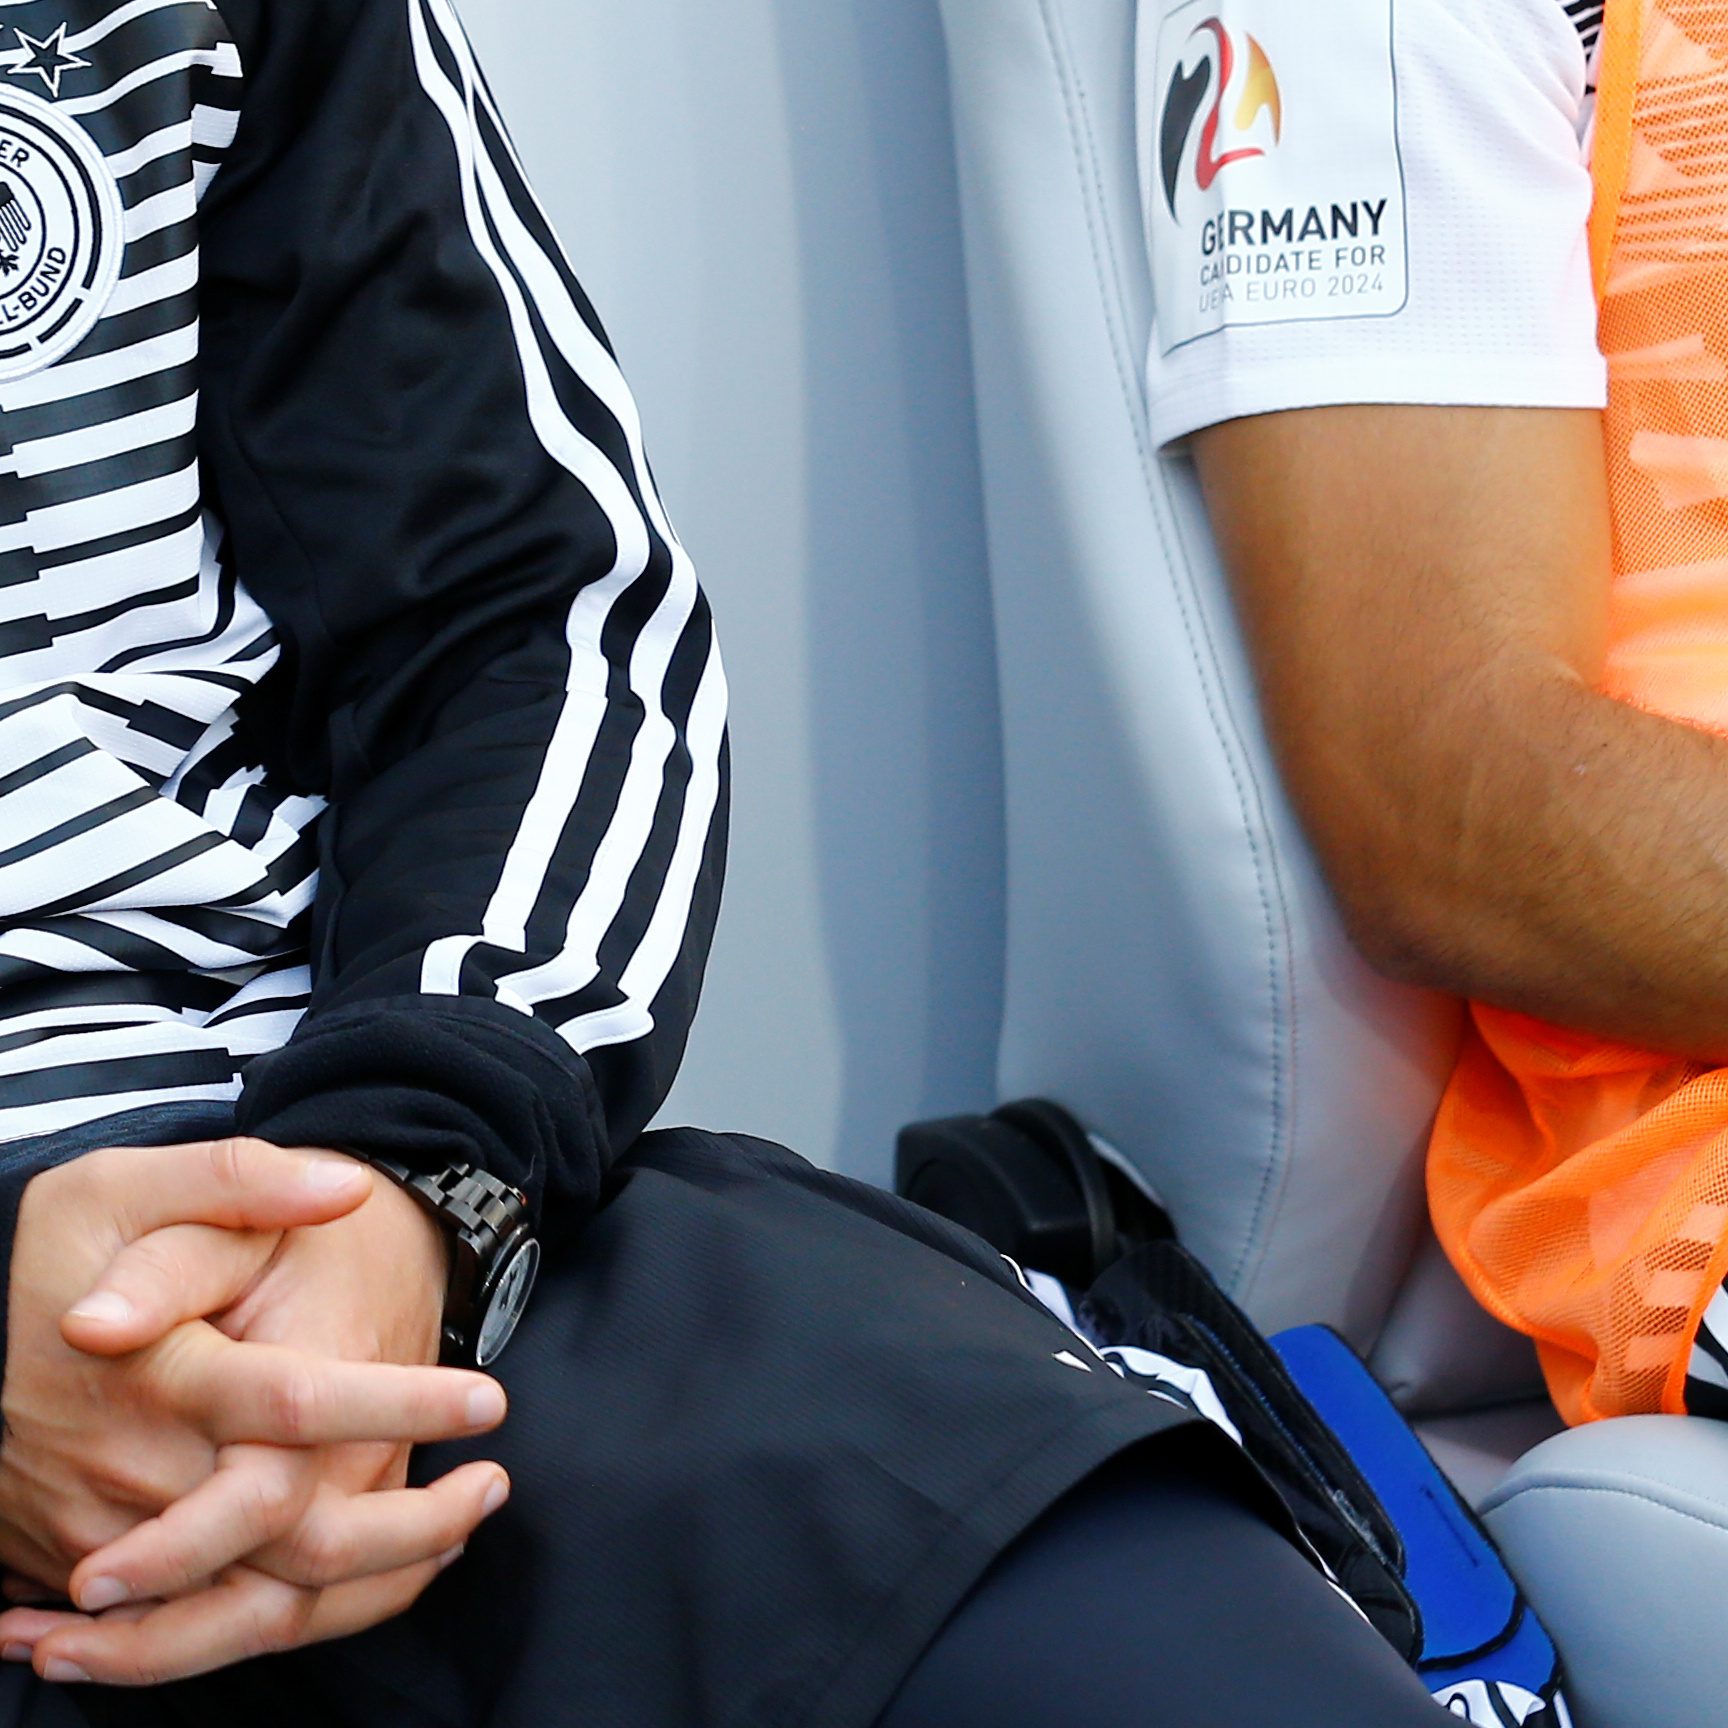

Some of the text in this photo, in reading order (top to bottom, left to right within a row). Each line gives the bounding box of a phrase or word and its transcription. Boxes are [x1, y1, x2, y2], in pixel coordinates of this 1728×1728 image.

[1199, 244, 1386, 287] CADIDATE FOR
[1198, 273, 1384, 314] UEA EURO 2024
